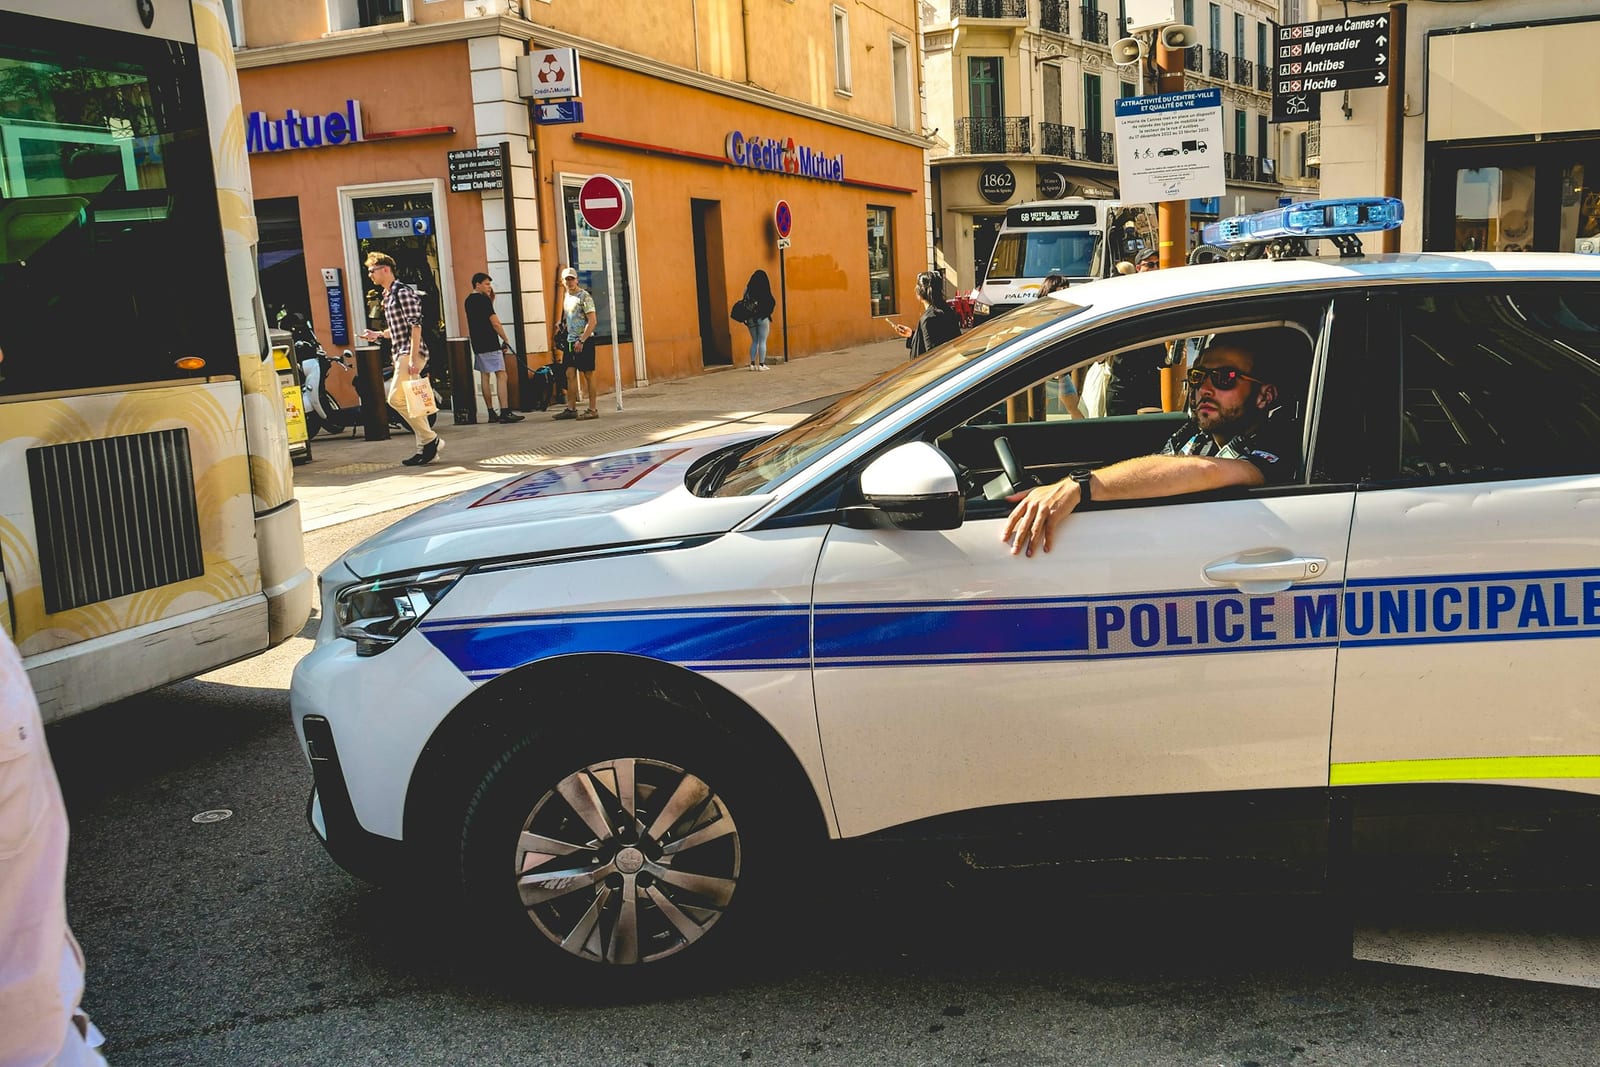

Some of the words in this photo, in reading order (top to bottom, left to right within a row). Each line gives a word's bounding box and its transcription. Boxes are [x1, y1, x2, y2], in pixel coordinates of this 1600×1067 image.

[1314, 24, 1334, 38] gare
[1335, 24, 1343, 33] de
[1344, 19, 1375, 31] Cannes
[1303, 38, 1361, 55] Meynadier
[1303, 60, 1345, 73] Antibes
[1303, 77, 1337, 91] Hoche
[1120, 97, 1162, 108] ATTRACTIVITÉ
[1172, 91, 1215, 102] CENTRE-VILLE
[1148, 102, 1175, 112] QUALITÉ
[247, 99, 361, 153] Mutuel
[730, 130, 783, 171] Crédit
[799, 145, 844, 181] Mutuel
[984, 173, 1012, 187] 1862
[387, 219, 410, 229] EURO
[1004, 292, 1031, 300] PALM
[1095, 597, 1277, 650] POLICE
[1293, 581, 1600, 640] MUNICIPALE
